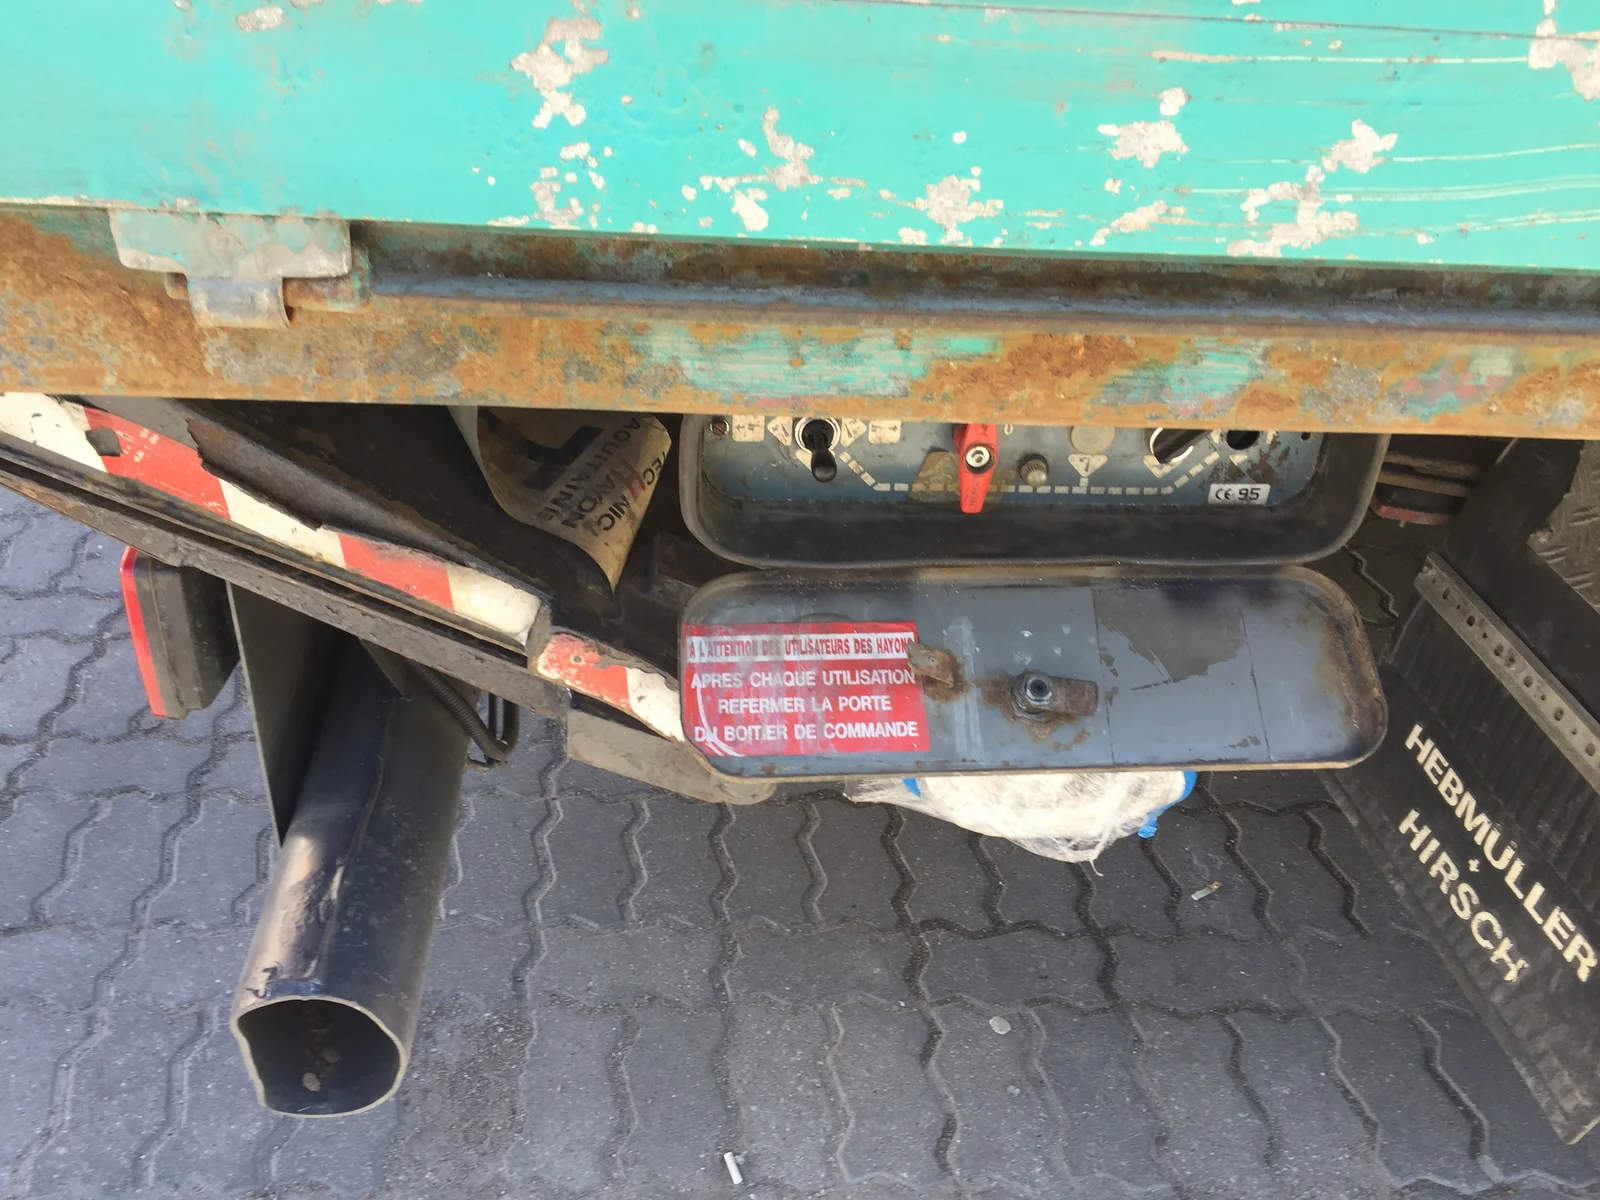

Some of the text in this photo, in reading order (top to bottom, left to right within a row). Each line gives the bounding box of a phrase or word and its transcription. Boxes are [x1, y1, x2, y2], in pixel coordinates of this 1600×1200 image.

[1237, 487, 1261, 501] 95
[784, 638, 850, 656] UTILISATEURS
[853, 637, 873, 655] DES
[691, 669, 916, 689] APRES CHAQUE UTILISATION
[718, 695, 892, 715] REFERMER LA PORTE
[694, 721, 919, 743] DU BOITIER DE COMMANDE
[1405, 723, 1599, 983] HEBMÜLLER
[1398, 809, 1530, 983] HIRSCH
